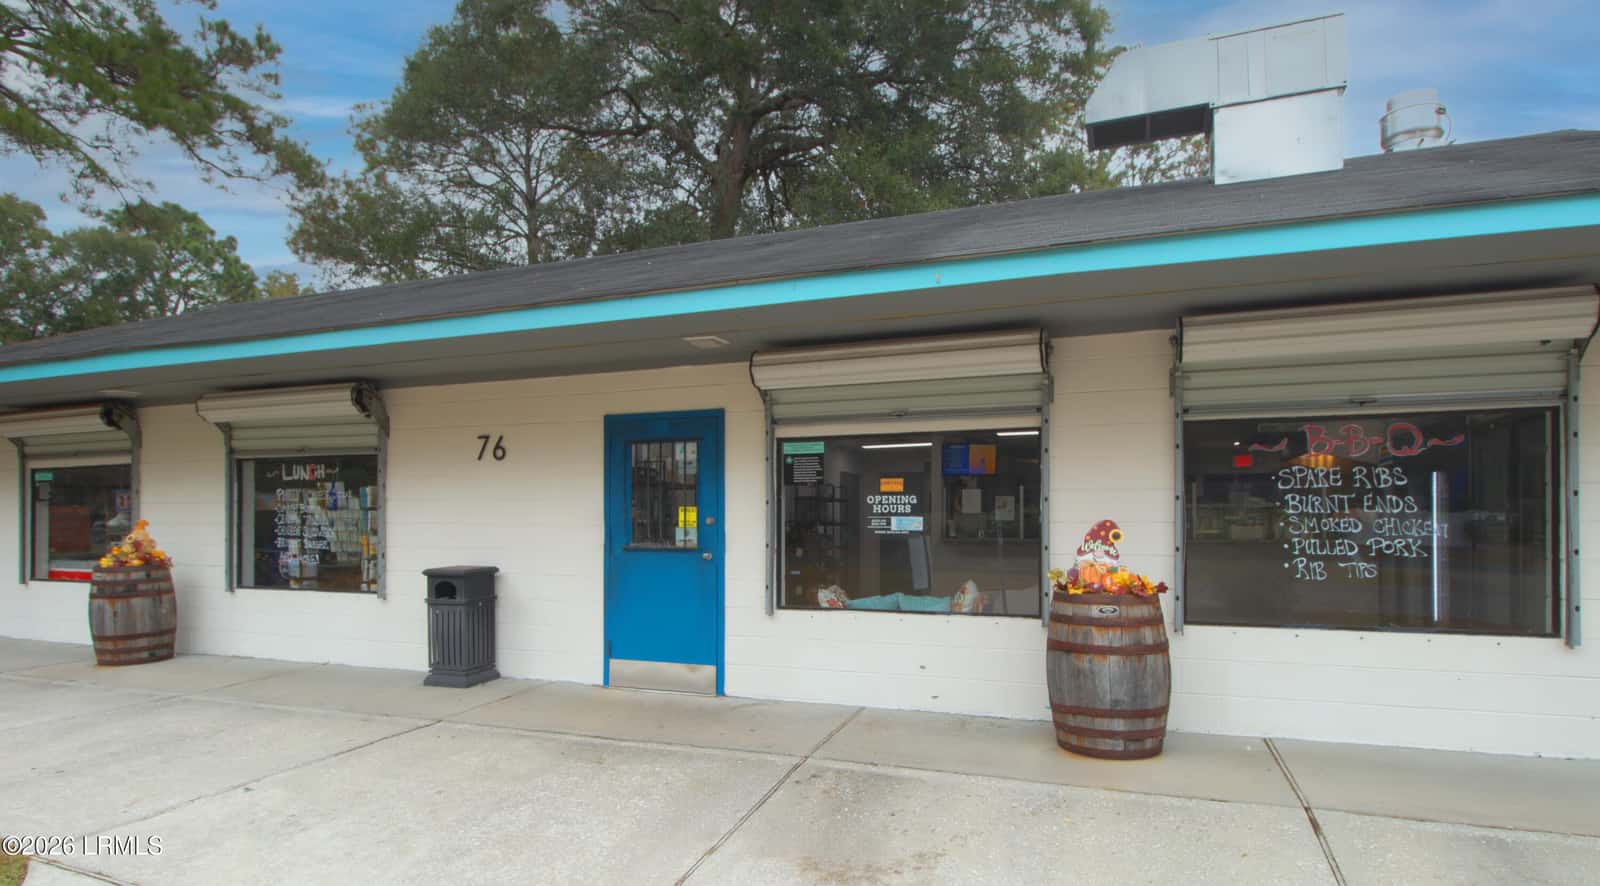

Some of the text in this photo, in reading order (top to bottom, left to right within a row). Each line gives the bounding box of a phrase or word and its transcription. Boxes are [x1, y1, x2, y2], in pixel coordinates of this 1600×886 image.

[477, 434, 506, 462] 76
[1301, 422, 1427, 457] B-B-Q
[281, 463, 325, 481] LUNCH
[1278, 465, 1409, 489] SPARE RIBS
[866, 495, 918, 504] OPENING
[872, 504, 912, 513] HOURS
[1284, 493, 1418, 514] BURNT ENDS
[1288, 517, 1449, 538] SMOKED CHICKEN
[1291, 537, 1429, 558] PULLED PORK
[1295, 557, 1379, 581] RIB TIPS
